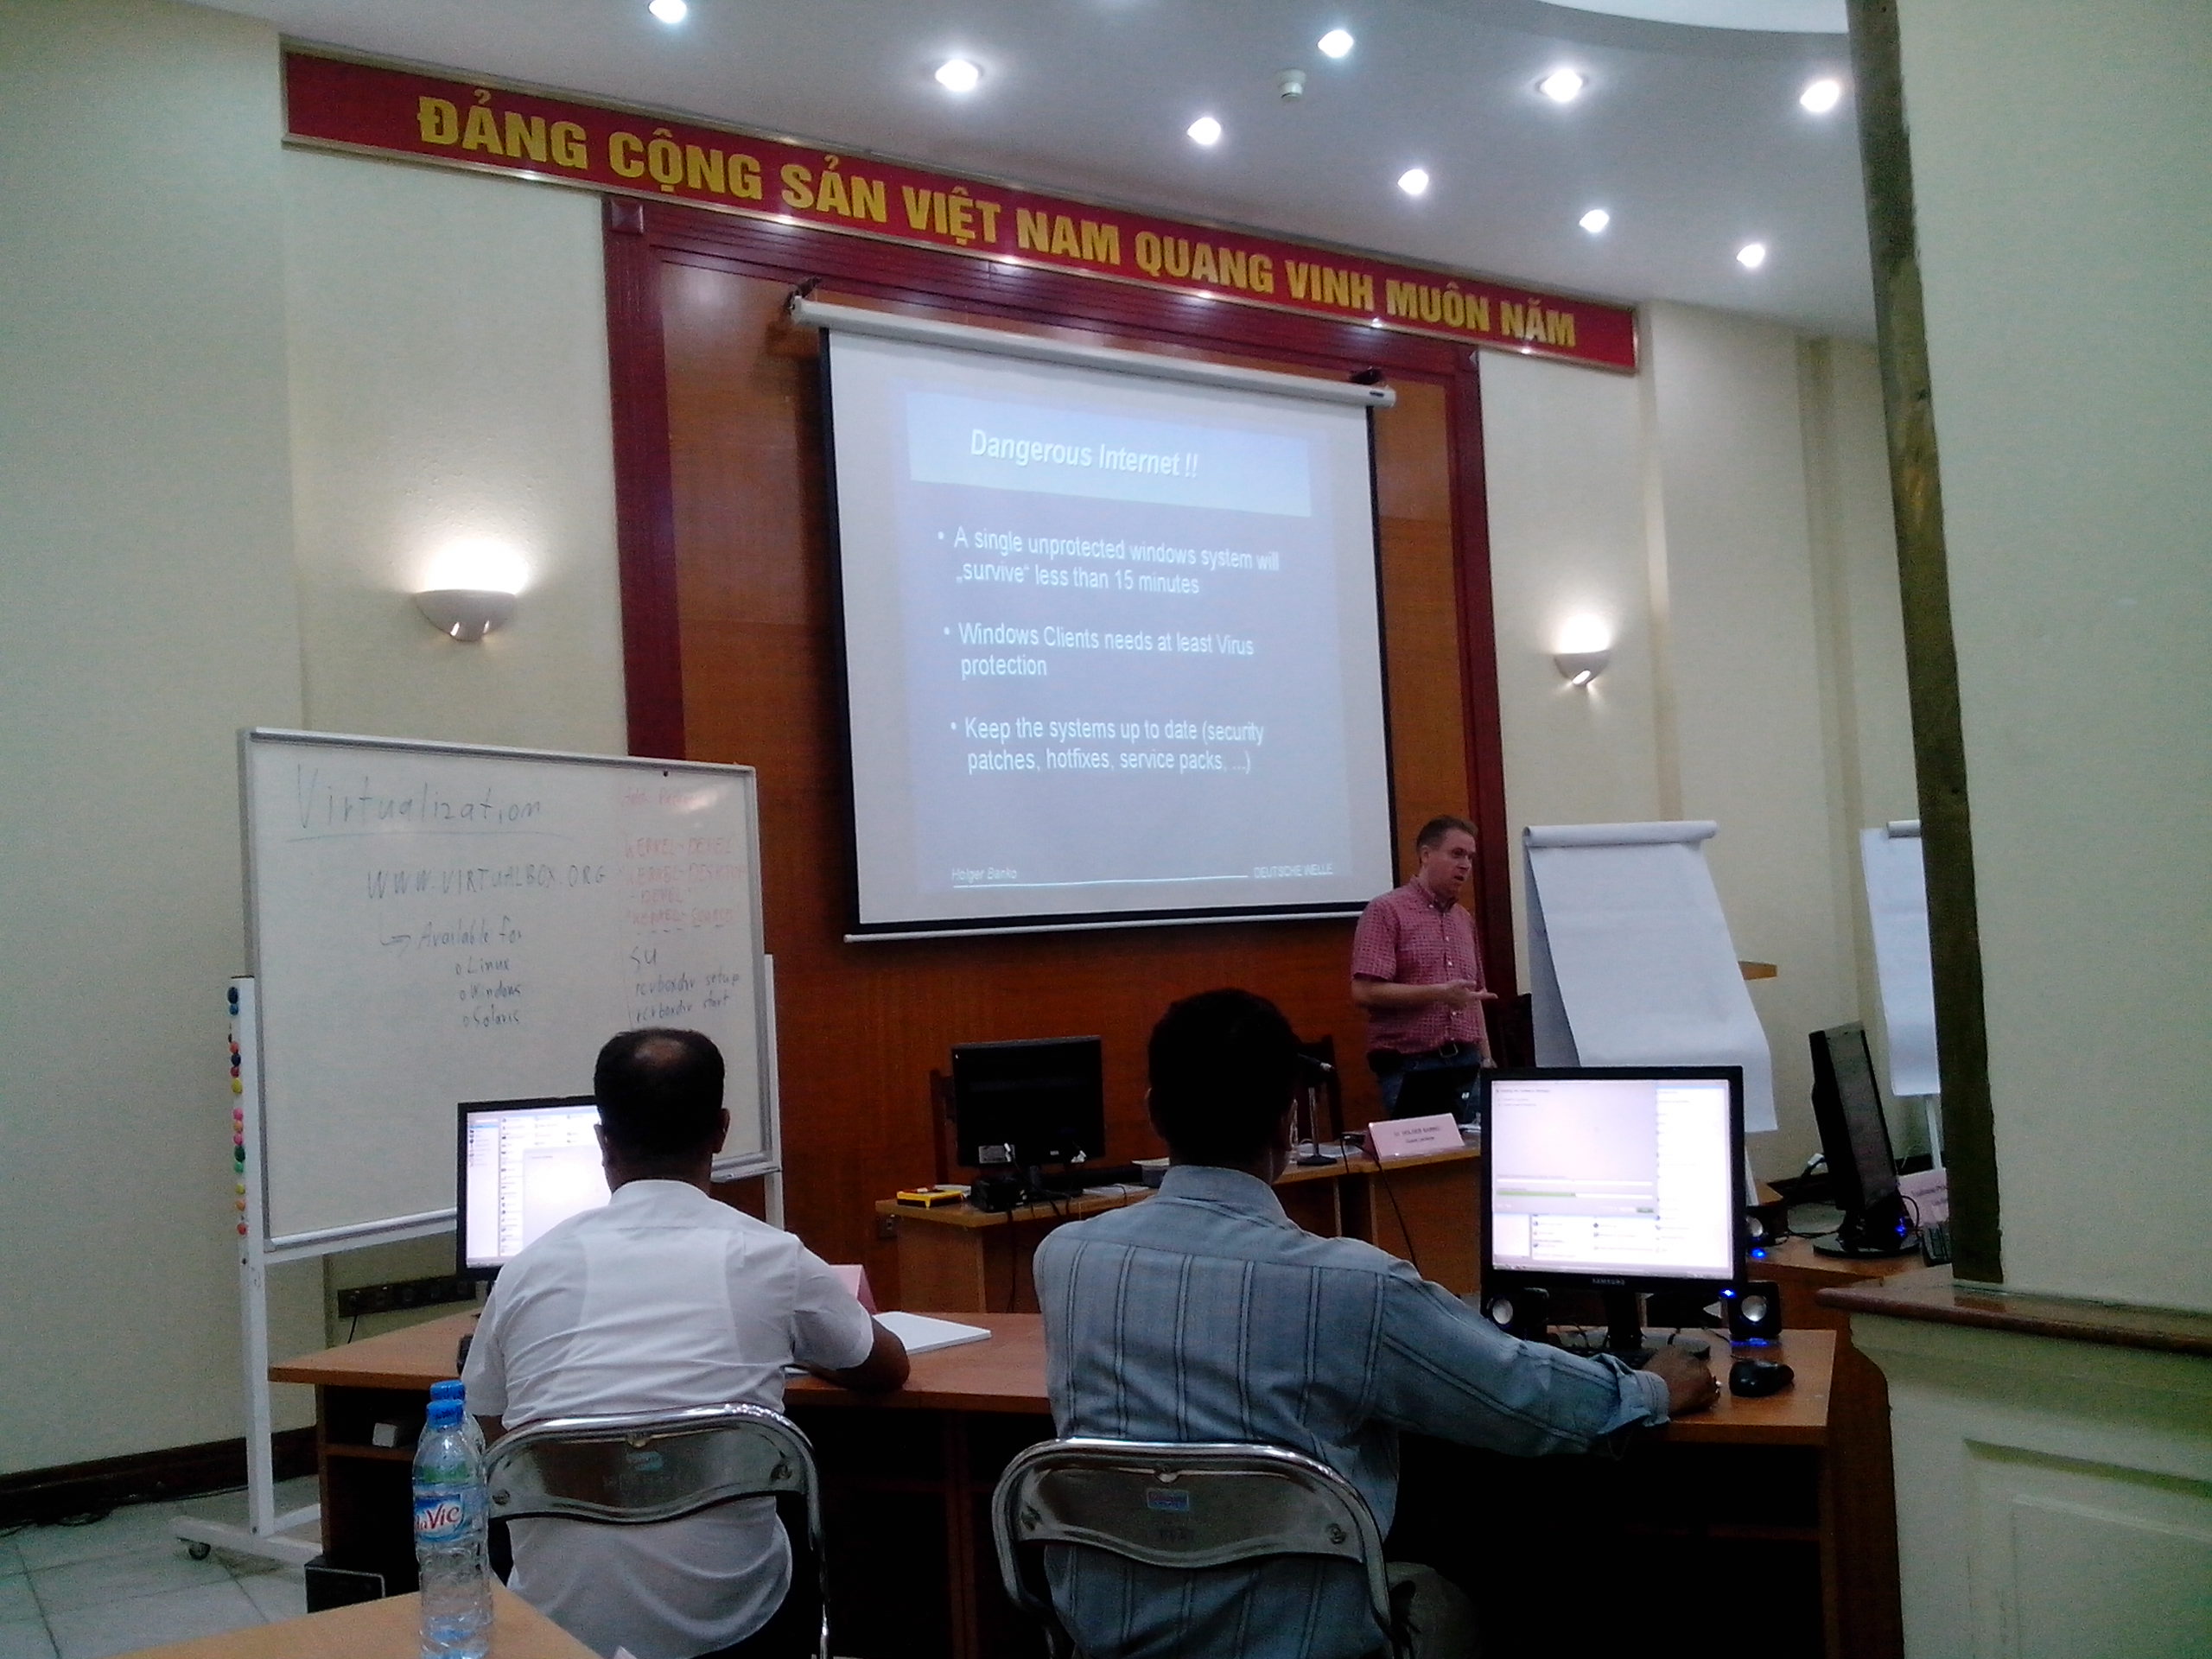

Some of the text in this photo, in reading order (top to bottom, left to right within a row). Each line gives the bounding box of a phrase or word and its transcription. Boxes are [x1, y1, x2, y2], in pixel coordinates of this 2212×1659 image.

[417, 88, 1577, 347] ĐẢNG CỘNG SẢN VIỆT NAM QUANG VINH MUÔN NĂM
[969, 429, 1199, 478] Dangerous Internet !!
[954, 526, 1280, 572] A single unprotected windows system will
[1035, 564, 1069, 586] less
[1072, 566, 1109, 588] than
[1116, 570, 1135, 590] 15
[1138, 573, 1199, 594] minutes
[958, 622, 1254, 656] Windows Clients needs at least Virus
[960, 655, 1047, 681] protection
[964, 716, 1264, 746] Keep the systems up to date (security
[968, 750, 1040, 774] patches,
[1046, 748, 1115, 770] hotfixes,
[1120, 750, 1175, 769] service
[1179, 751, 1228, 773] packs,
[297, 764, 540, 829] Virtualization
[1254, 865, 1303, 878] DEUTSCHE
[705, 966, 741, 988] setup
